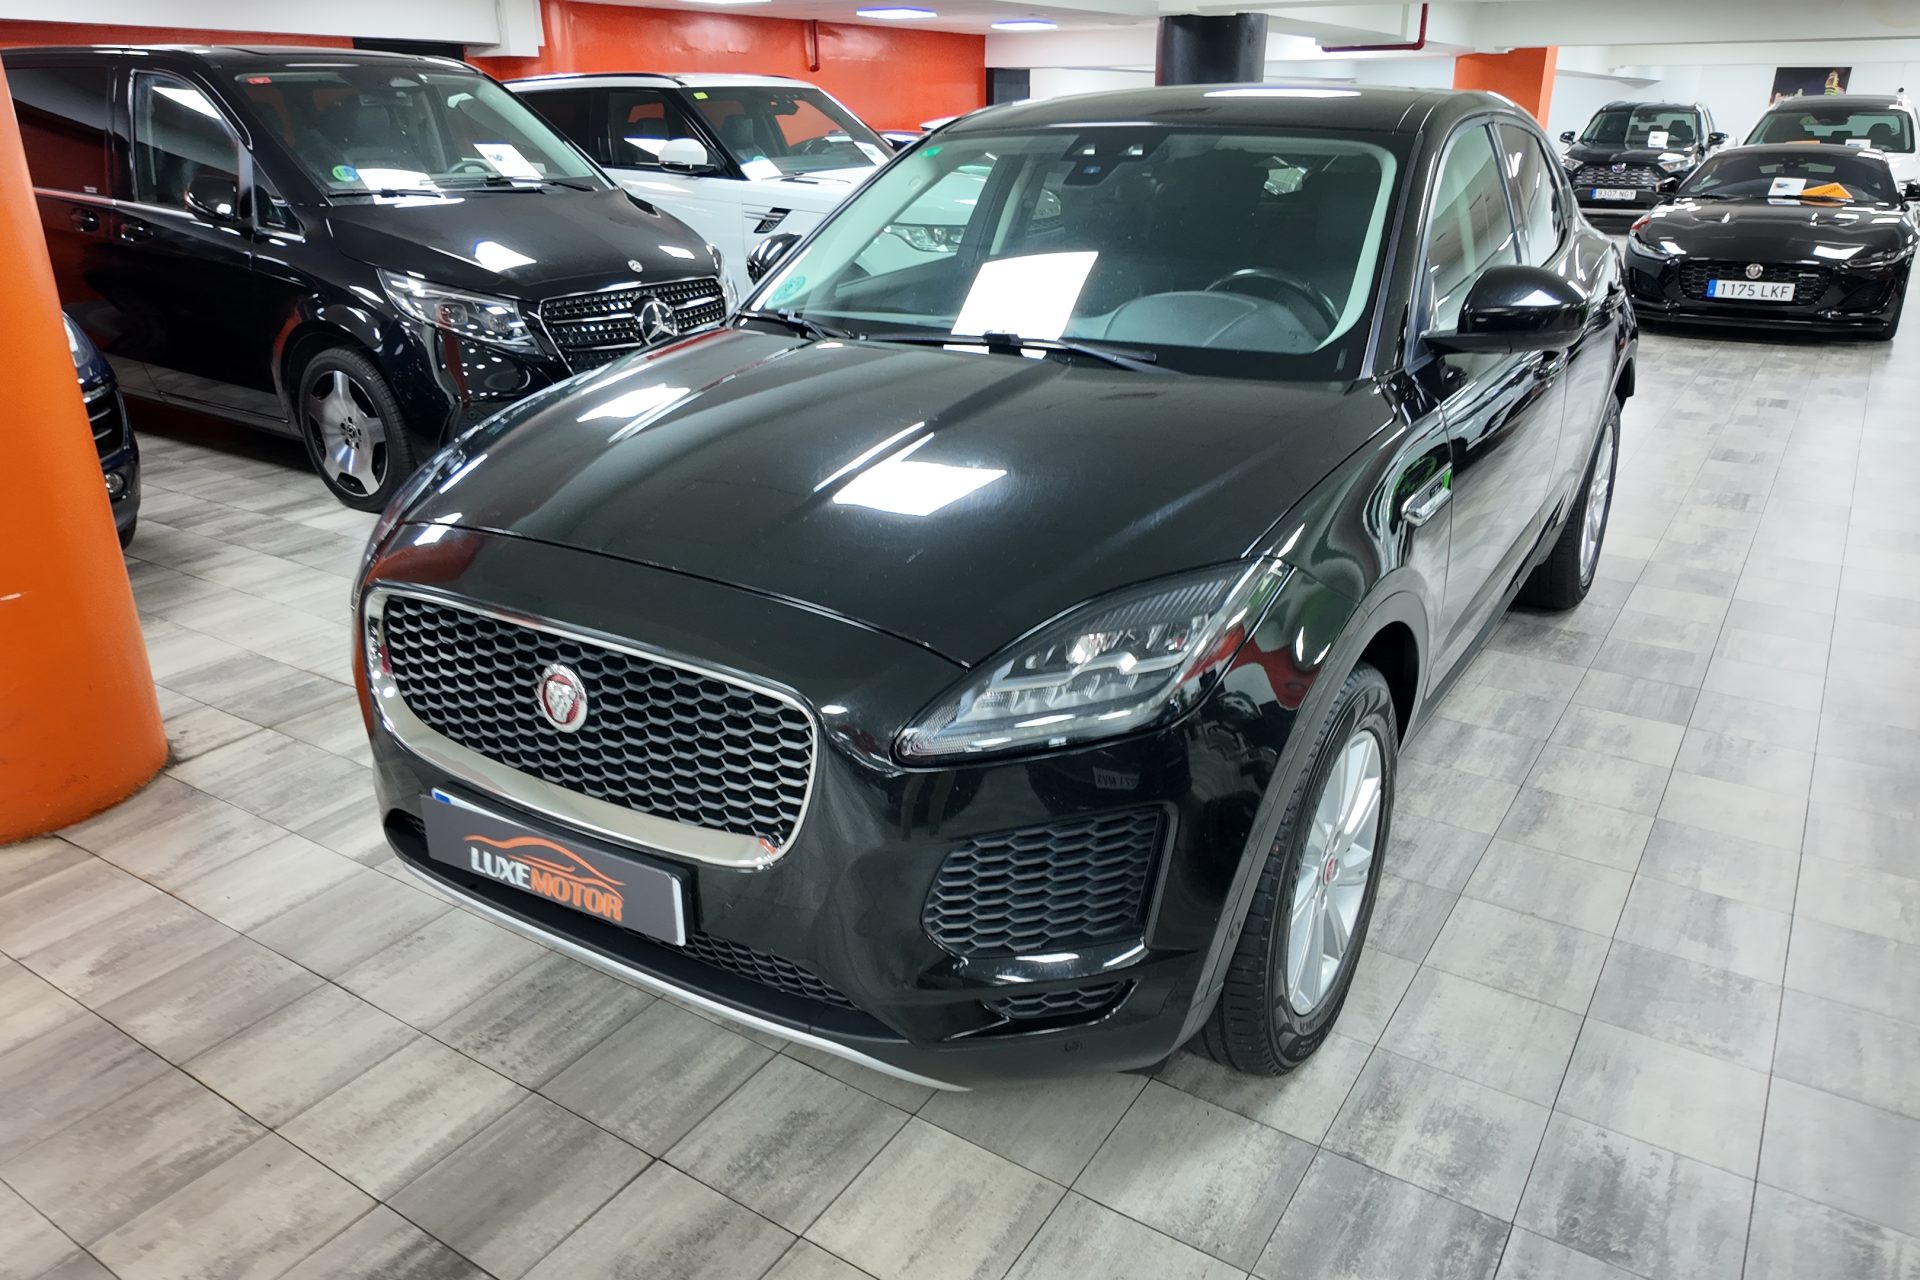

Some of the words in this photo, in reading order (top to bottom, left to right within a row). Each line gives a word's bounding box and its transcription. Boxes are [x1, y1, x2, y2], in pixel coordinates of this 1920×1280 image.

[1721, 283, 1756, 297] 1175
[1760, 284, 1790, 299] LKF
[470, 845, 624, 923] LUXEMOTOR
